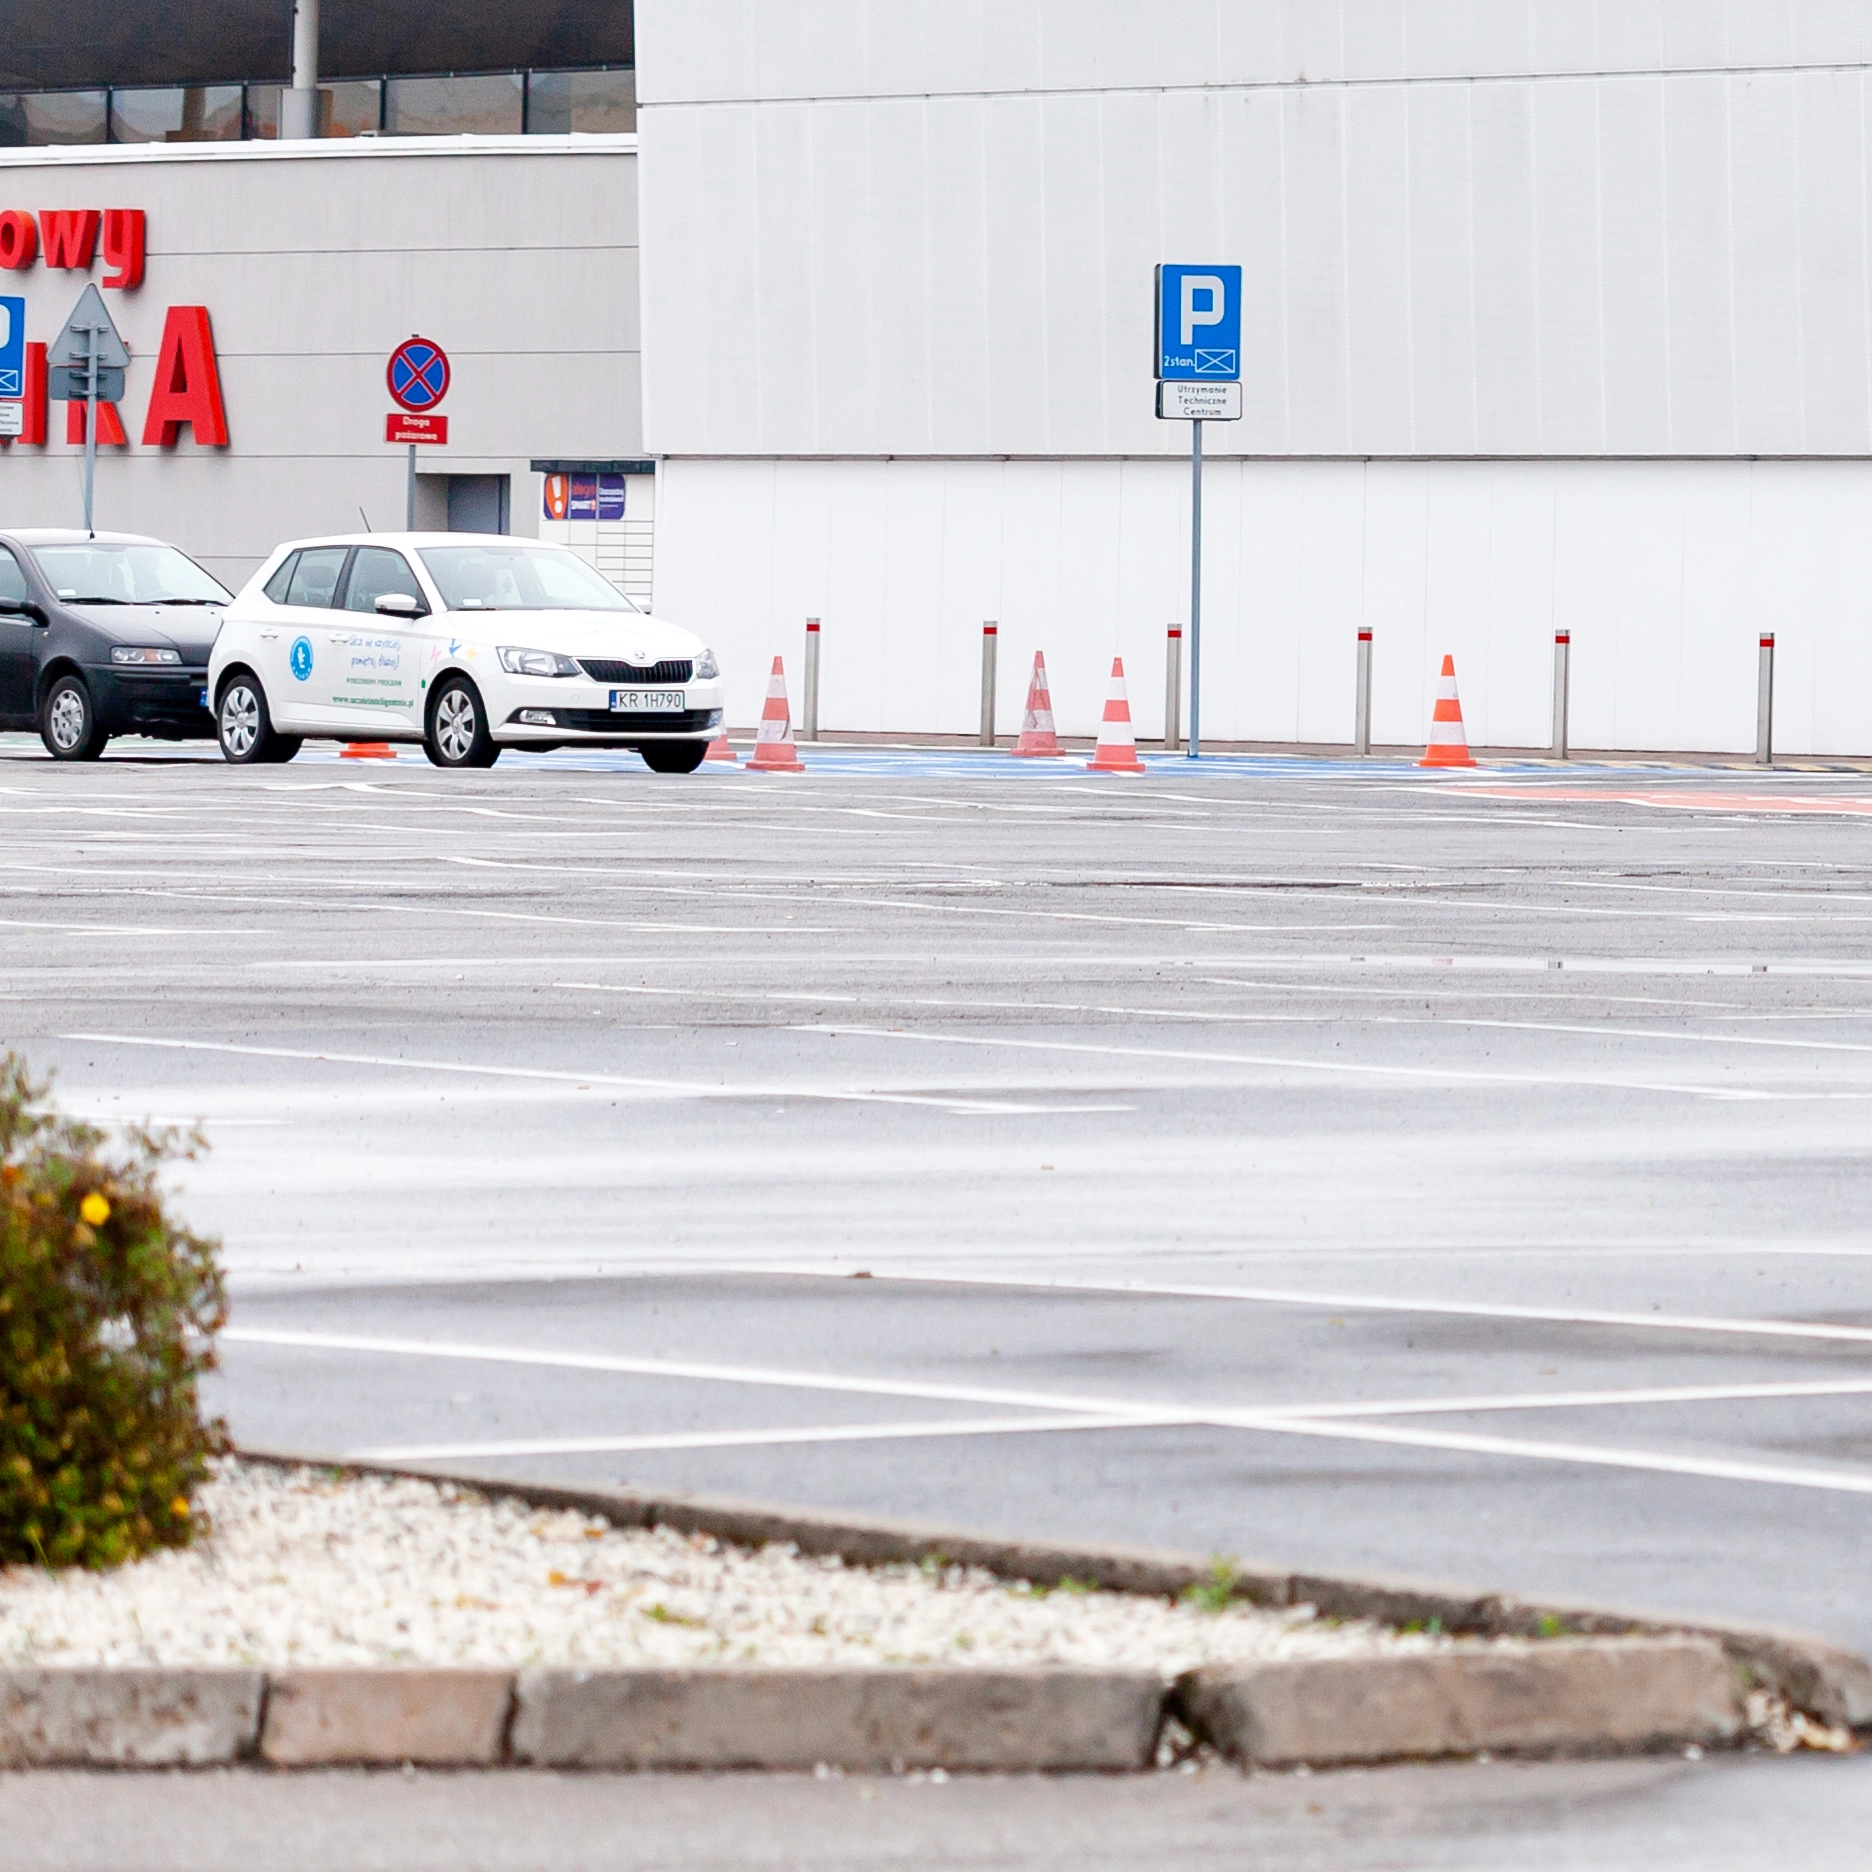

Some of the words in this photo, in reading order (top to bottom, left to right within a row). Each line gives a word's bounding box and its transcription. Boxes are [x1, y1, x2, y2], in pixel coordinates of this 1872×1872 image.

[1181, 275, 1225, 345] P
[1177, 385, 1227, 395] Utrzymanie
[1178, 395, 1227, 405] Techniczne
[1183, 406, 1222, 416] Centrum
[619, 693, 638, 708] KR
[644, 693, 681, 708] 1H790
